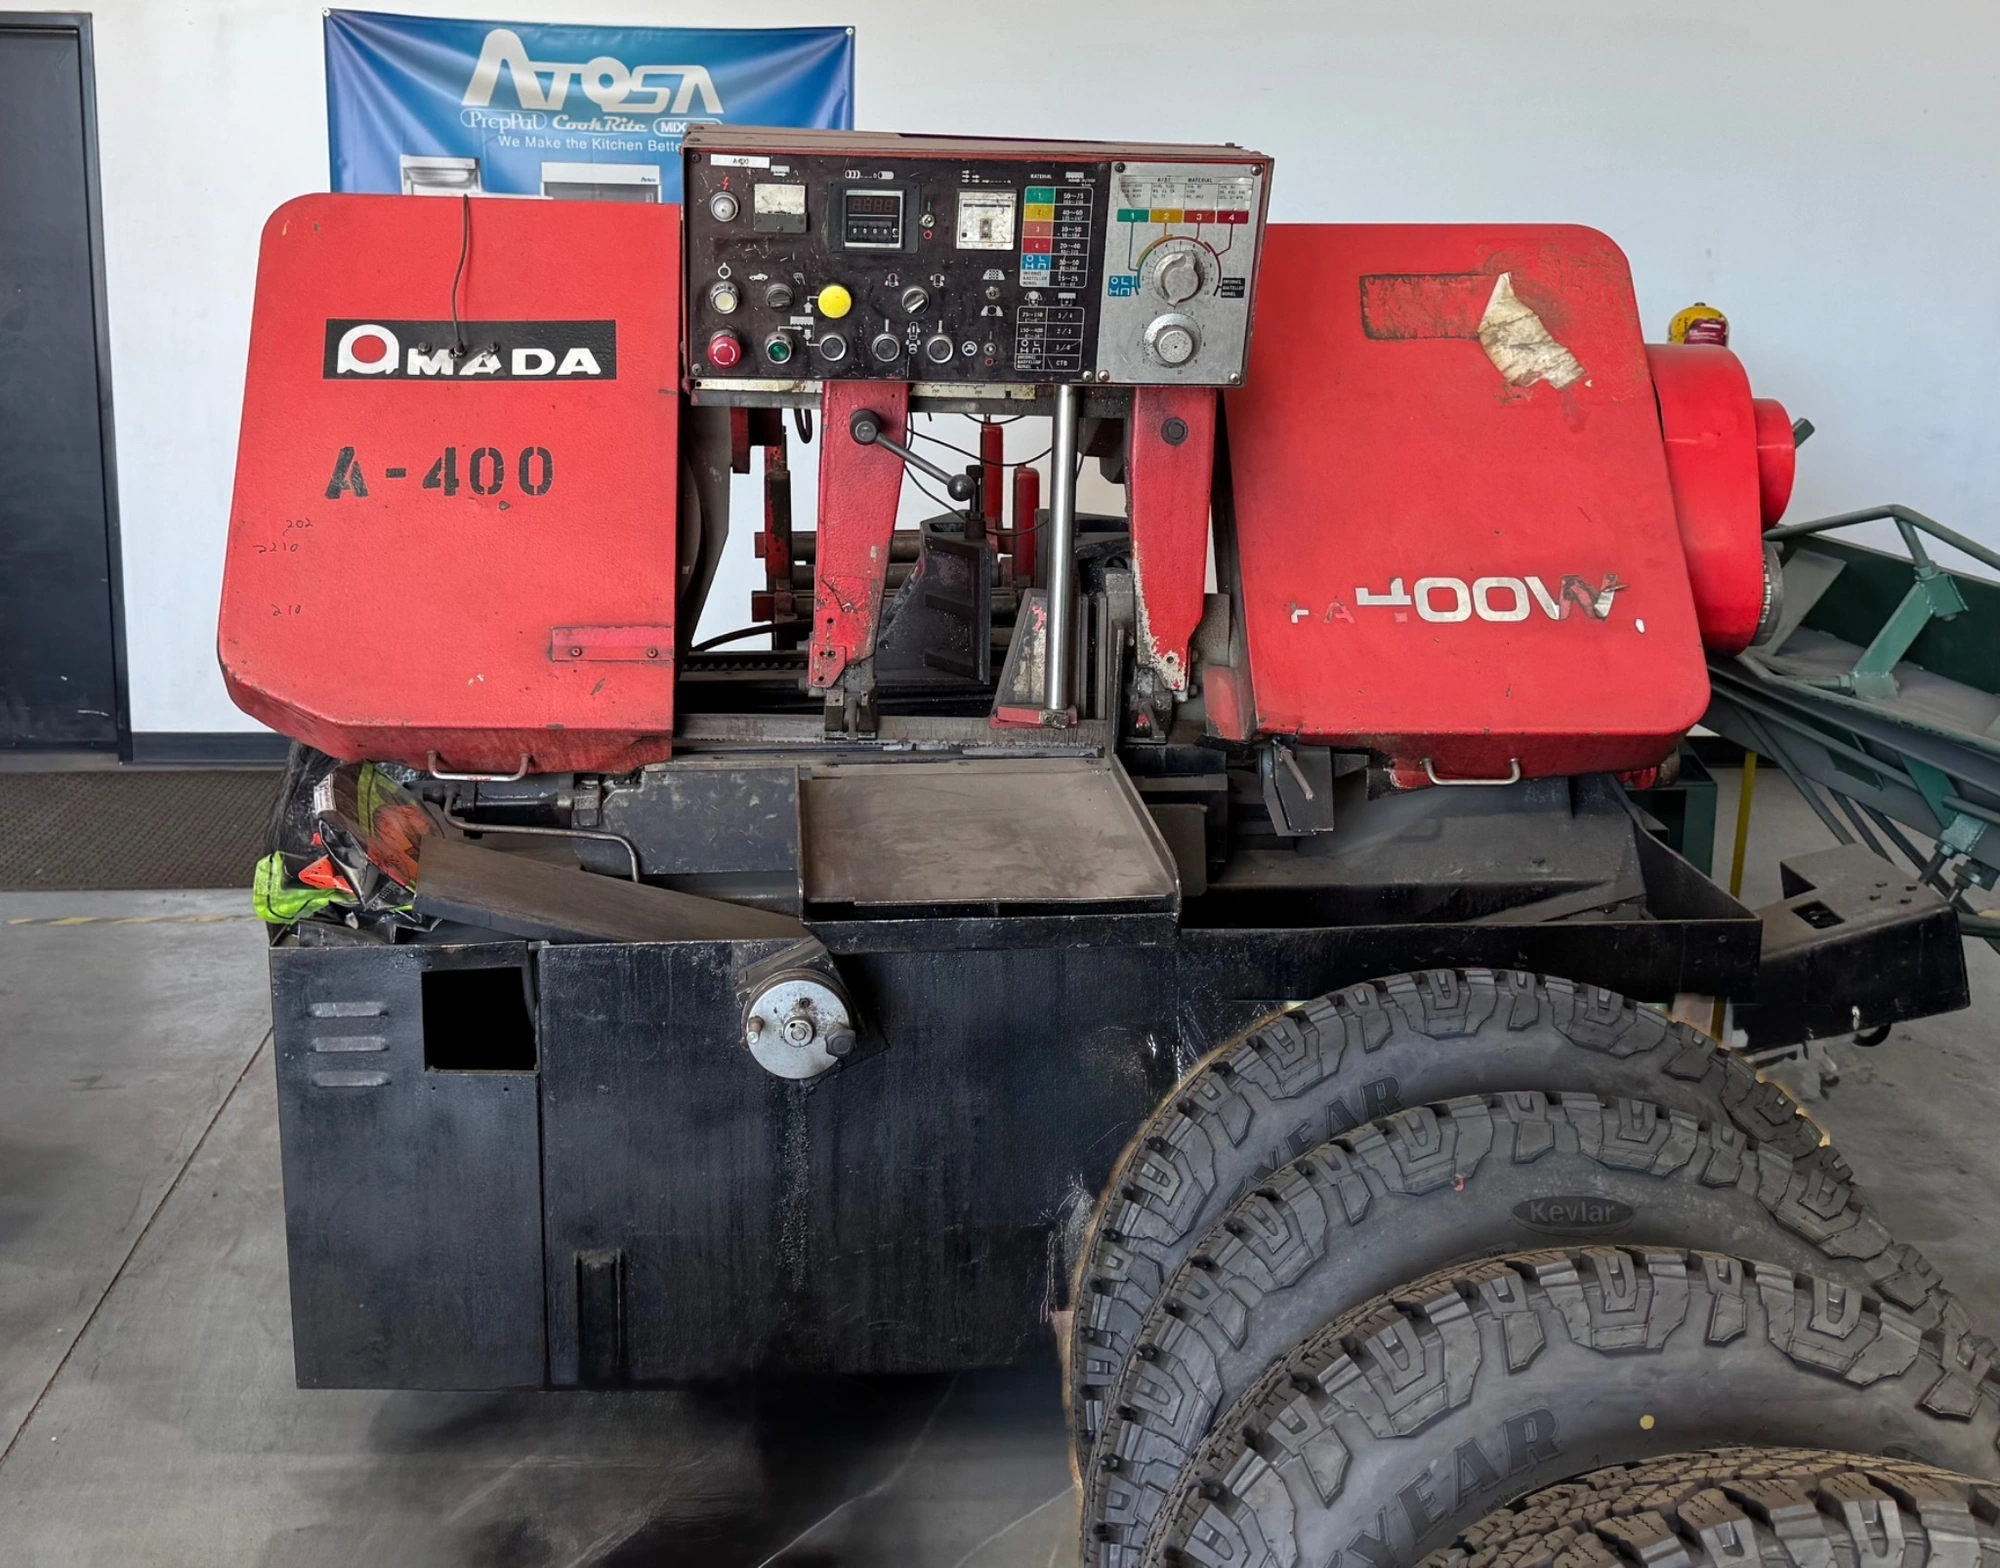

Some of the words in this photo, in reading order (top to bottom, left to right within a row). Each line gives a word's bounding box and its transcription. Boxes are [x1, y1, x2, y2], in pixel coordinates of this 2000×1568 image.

[461, 28, 724, 115] ATOSA
[468, 111, 541, 133] PrepPal
[498, 135, 520, 147] We
[525, 137, 561, 149] Make
[566, 138, 587, 149] the
[592, 138, 643, 151] Kitchen
[1163, 212, 1169, 220] 2
[1196, 213, 1202, 221] 3
[1228, 213, 1235, 221] 4
[336, 323, 602, 376] AMADA
[324, 446, 553, 500] A-400
[1530, 1201, 1616, 1223] Kevlar
